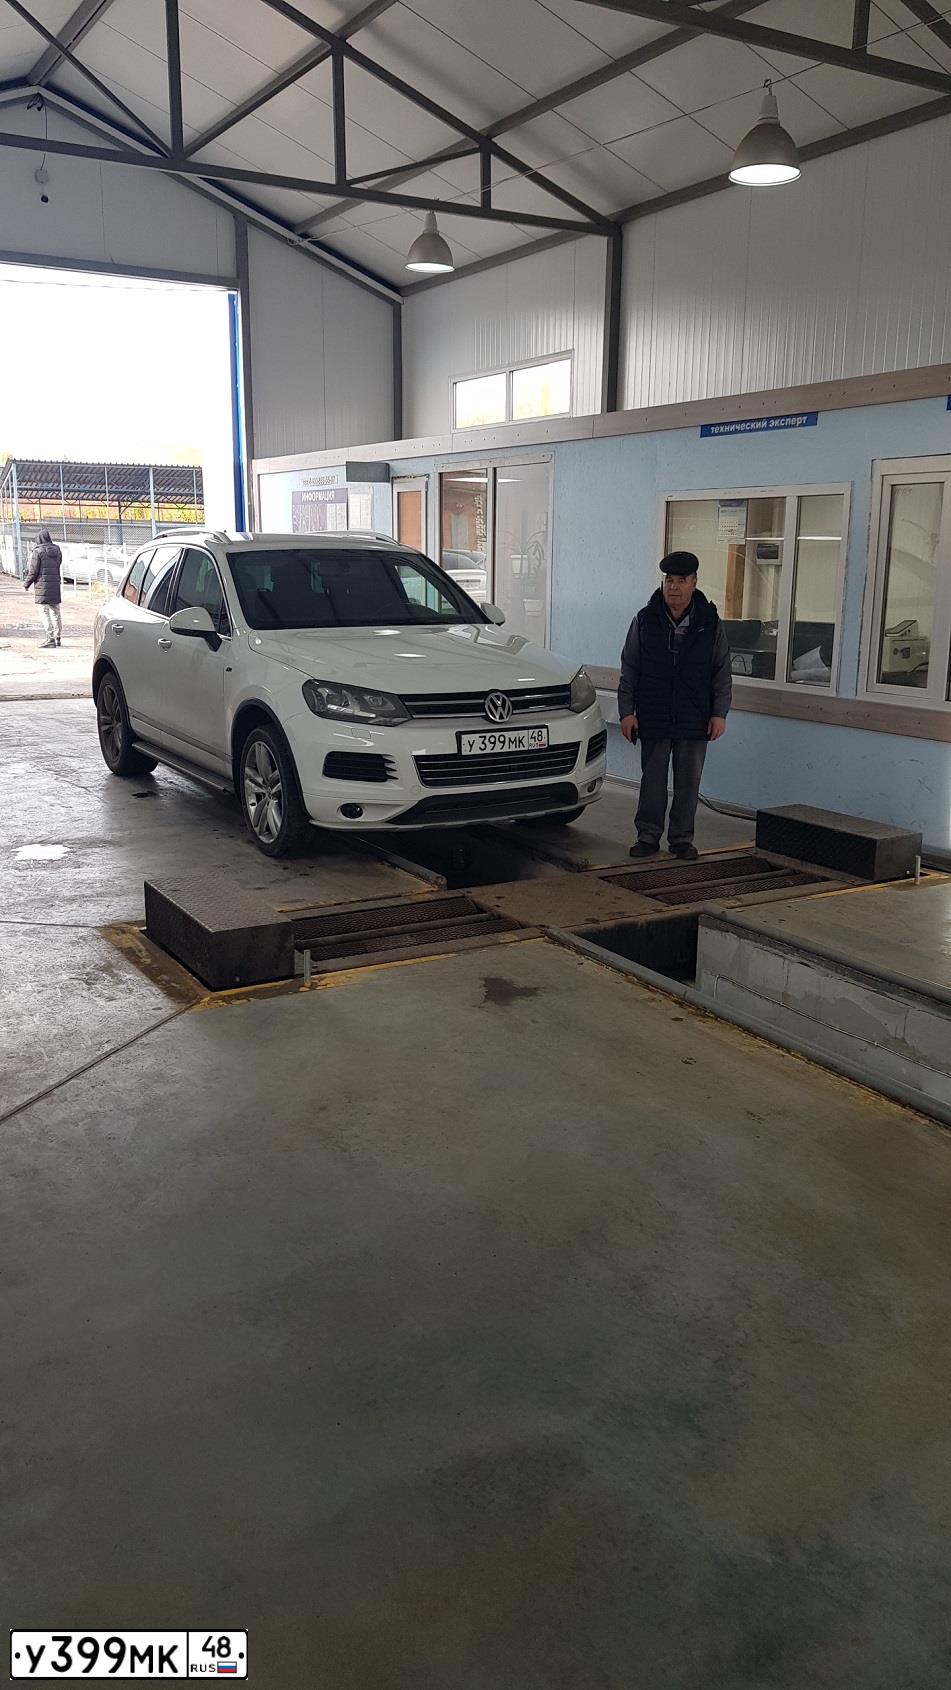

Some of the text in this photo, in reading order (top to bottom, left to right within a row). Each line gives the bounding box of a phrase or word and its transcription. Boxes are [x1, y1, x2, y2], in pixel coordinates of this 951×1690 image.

[710, 415, 808, 434] технический эксперт
[301, 490, 335, 502] ИНФОРМАЦИЯ
[529, 729, 544, 743] 48
